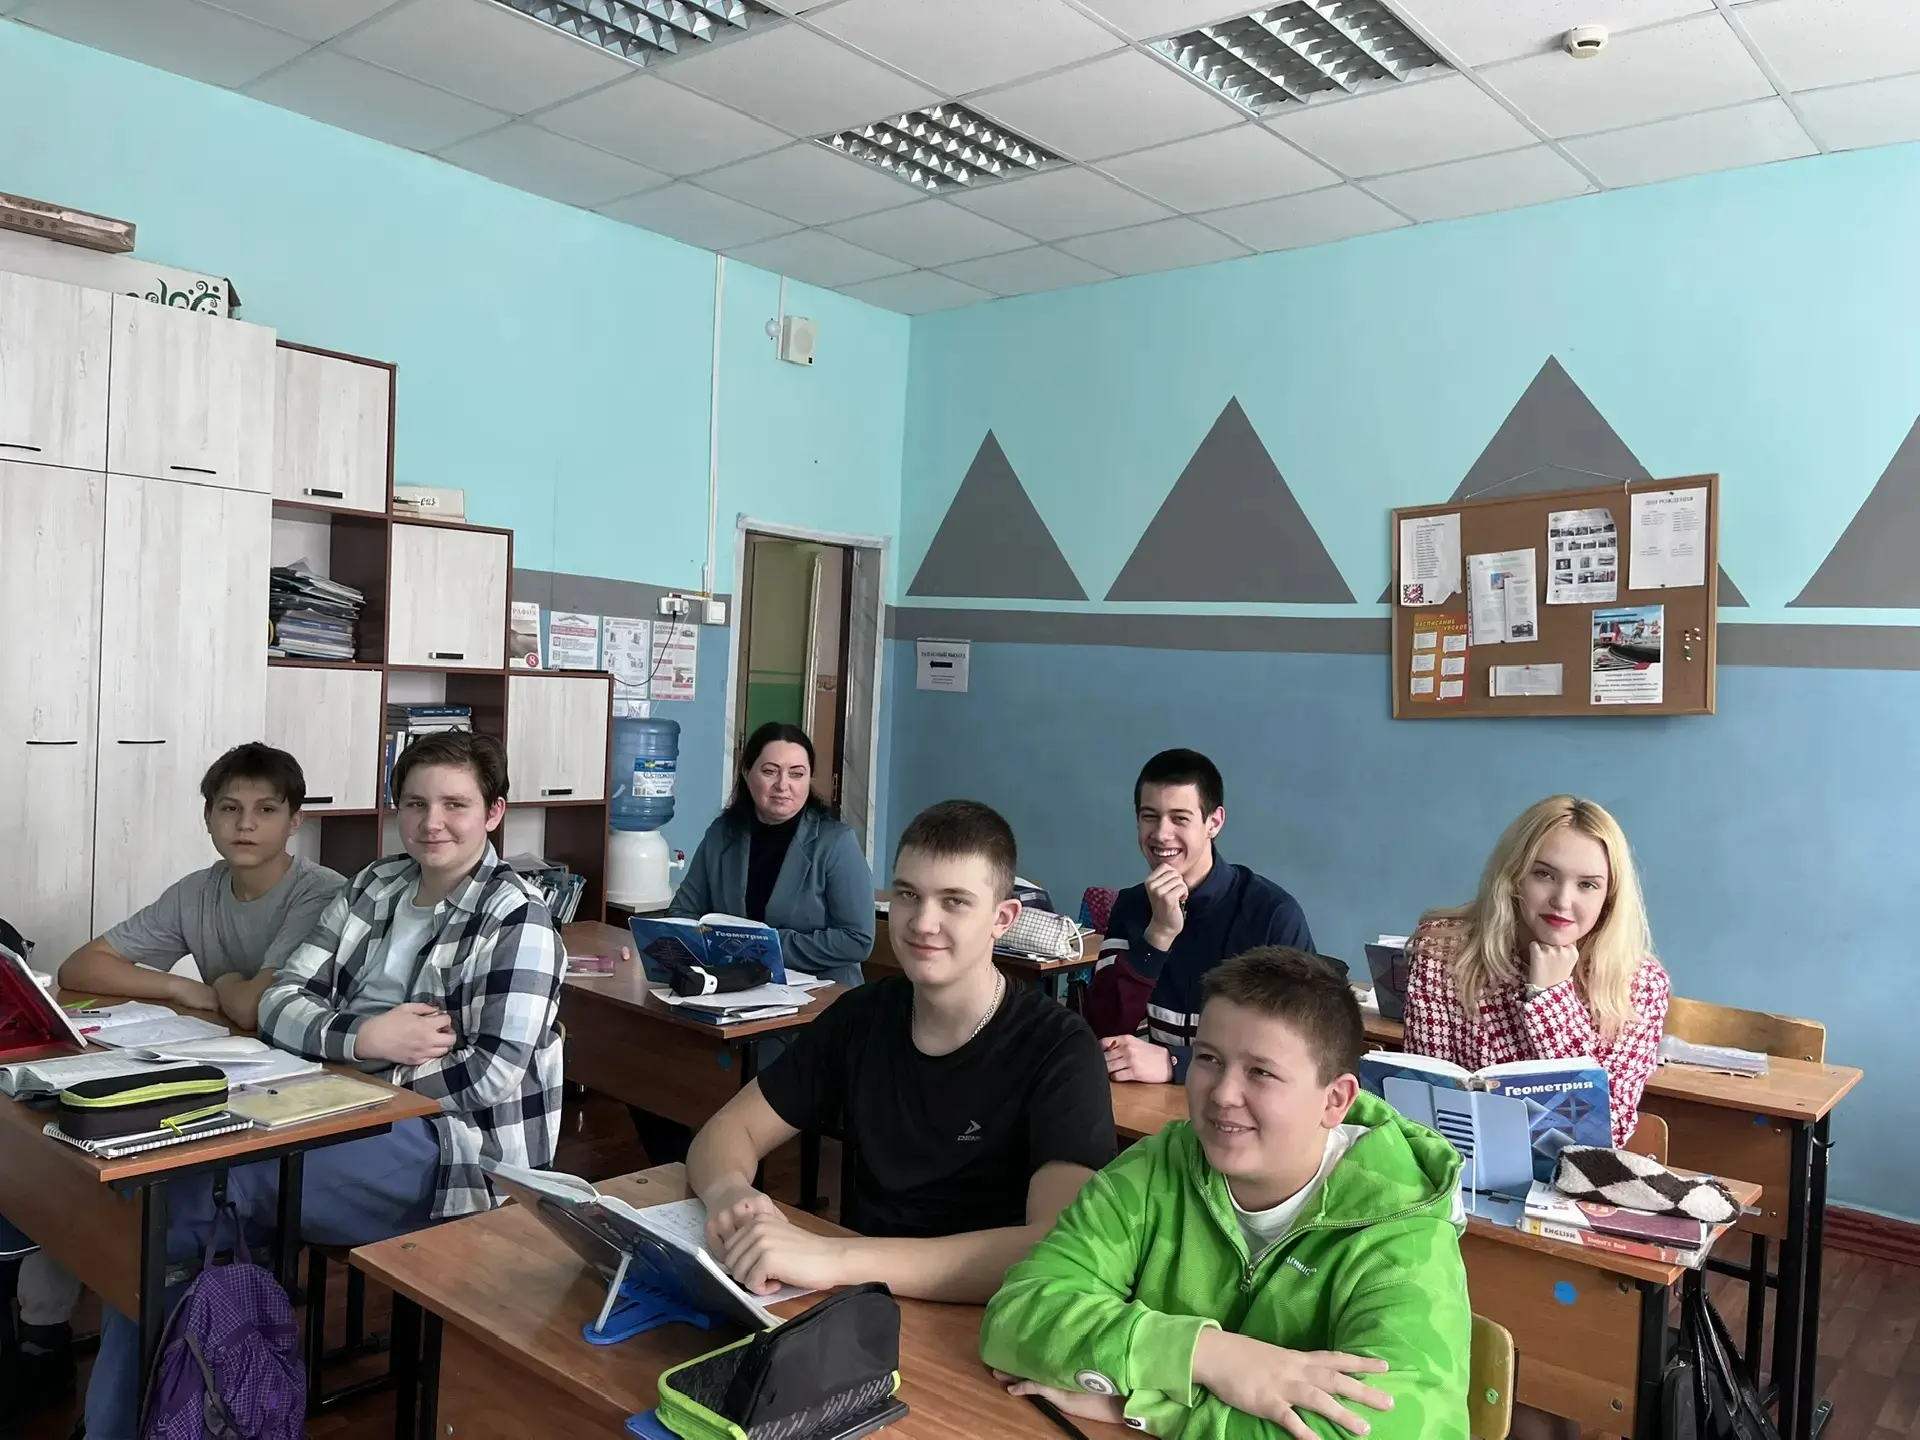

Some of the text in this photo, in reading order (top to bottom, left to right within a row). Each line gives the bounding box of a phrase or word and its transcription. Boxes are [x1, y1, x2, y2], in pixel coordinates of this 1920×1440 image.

[528, 655, 537, 666] 8
[715, 930, 769, 940] Геометрия
[1505, 1081, 1594, 1097] Геометрия
[1544, 1227, 1576, 1239] ENGLISH
